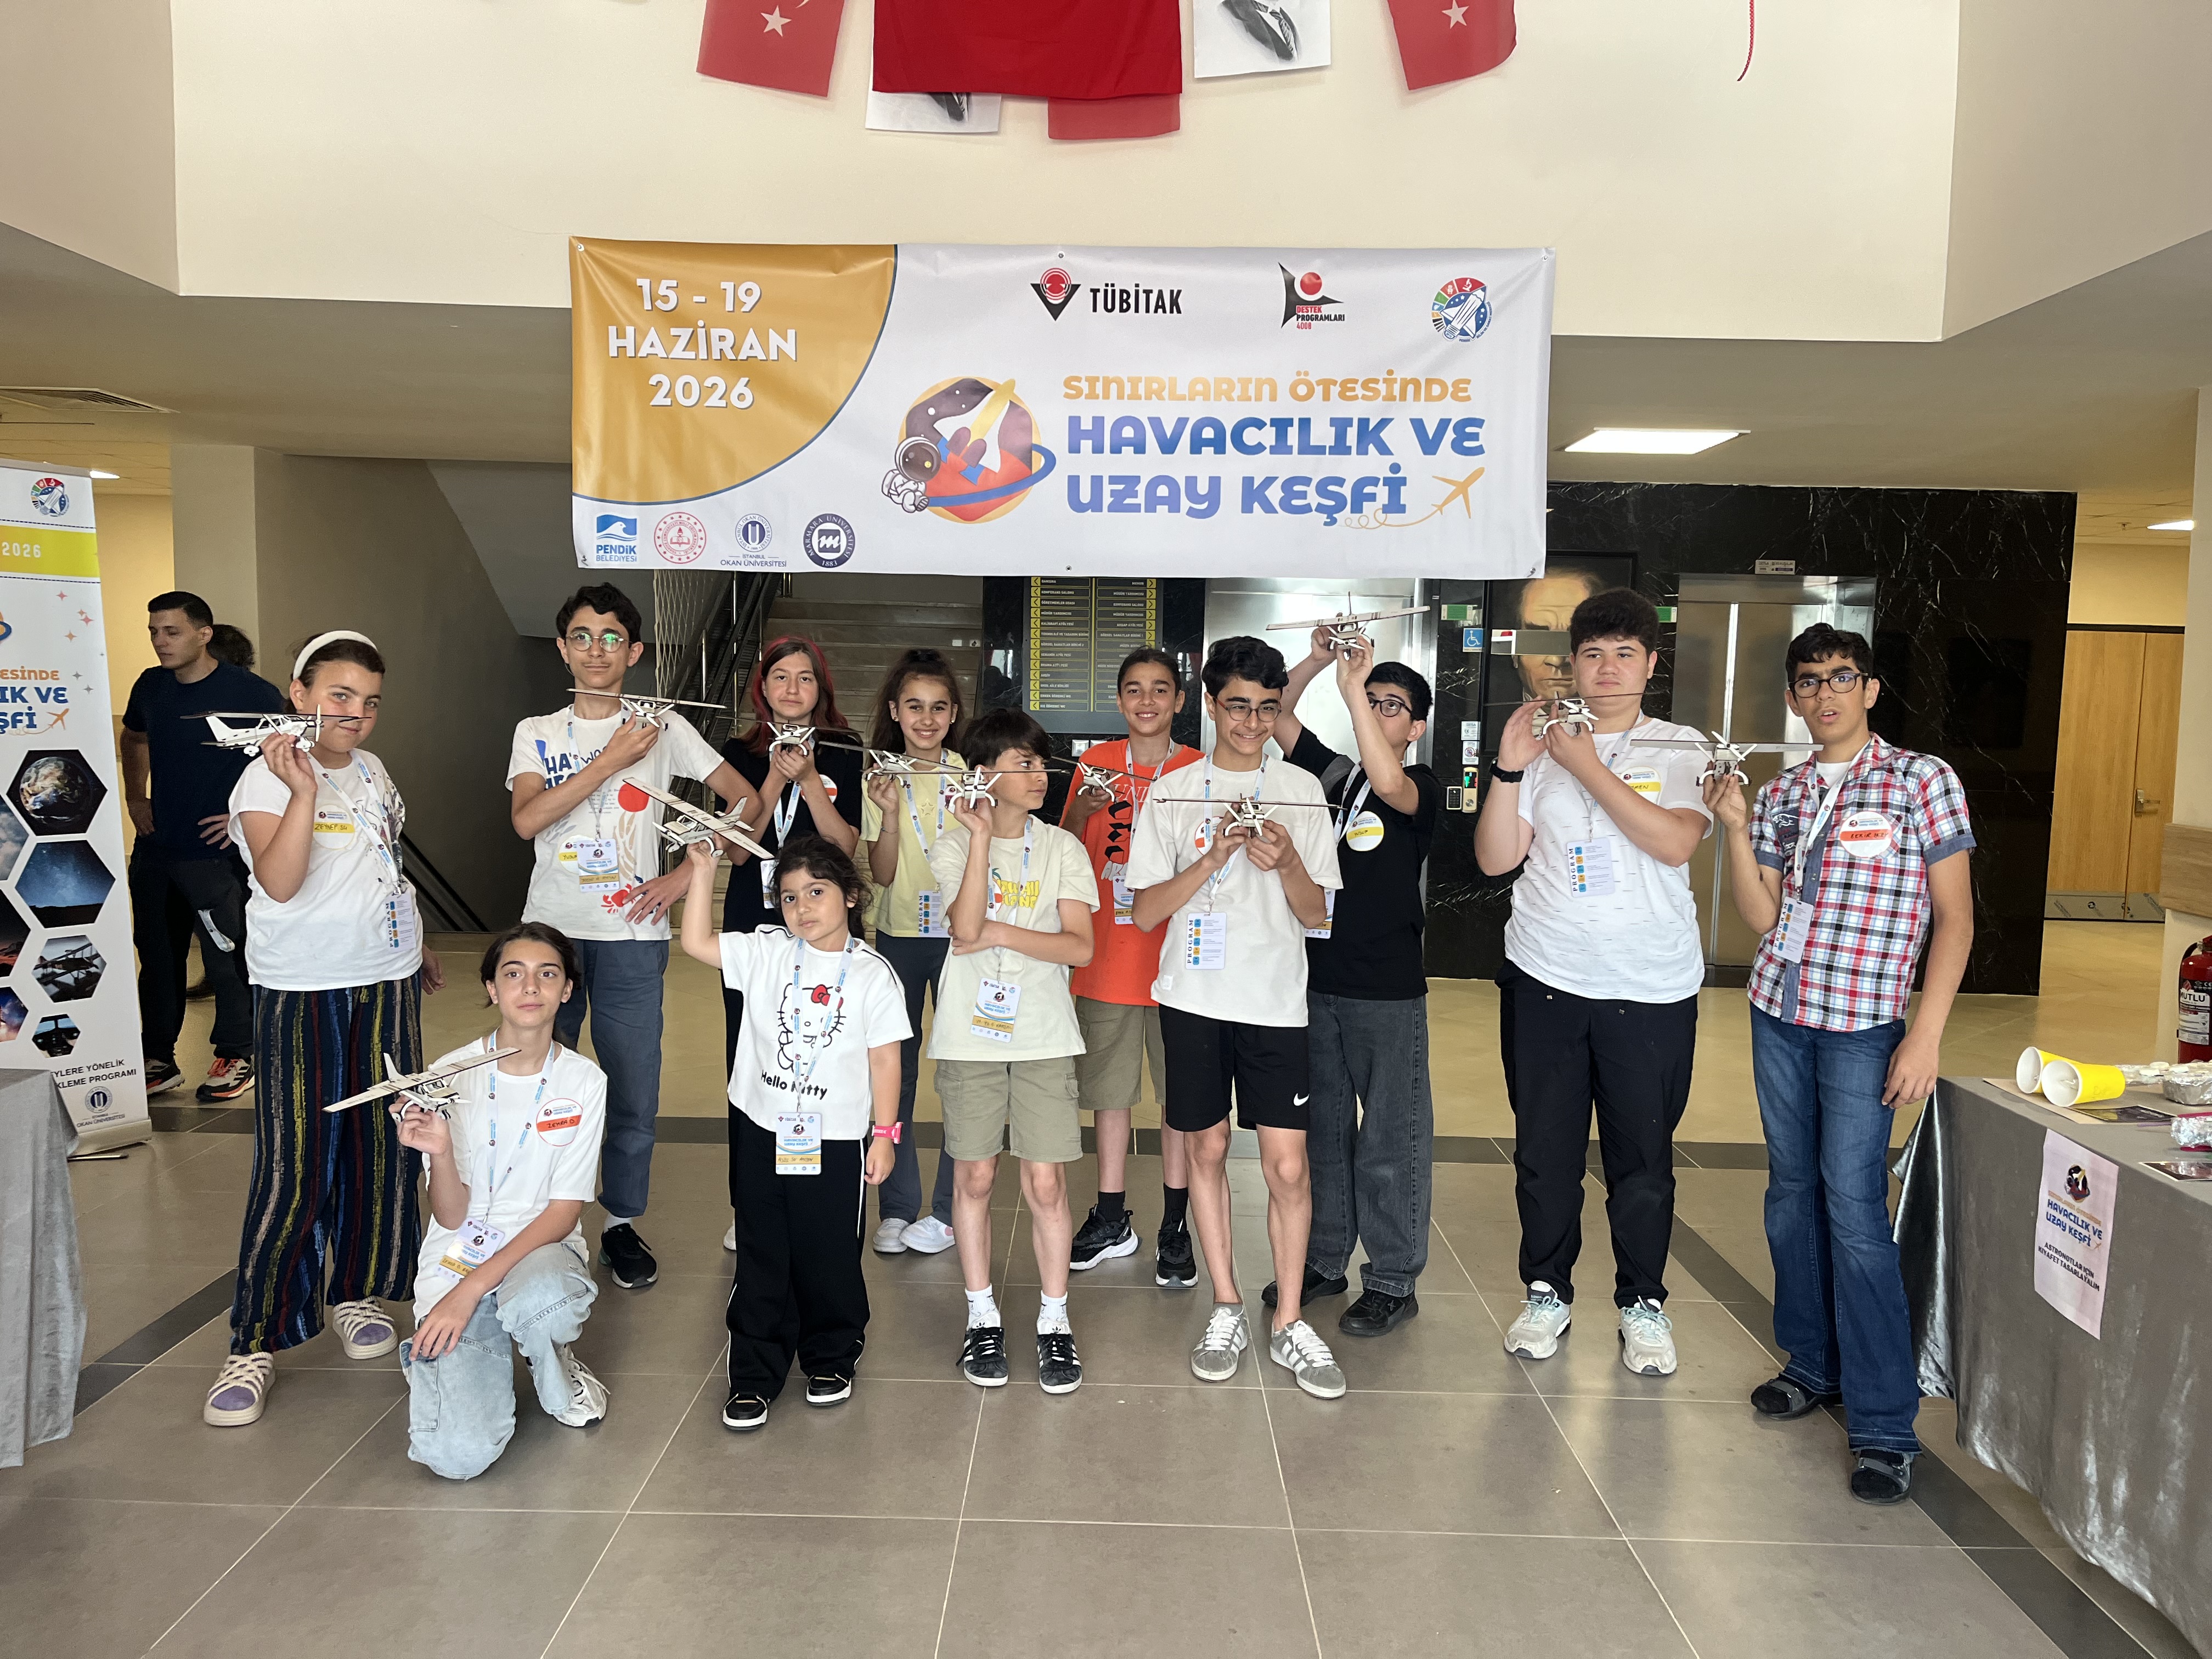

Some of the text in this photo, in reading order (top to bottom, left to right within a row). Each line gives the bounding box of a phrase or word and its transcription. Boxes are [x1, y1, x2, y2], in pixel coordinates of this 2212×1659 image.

[636, 279, 678, 312] 15
[720, 281, 761, 312] 19
[1090, 282, 1183, 315] TÜBİTAK
[608, 319, 797, 362] HAZİRAN
[648, 374, 754, 409] 2026
[1063, 369, 1472, 403] SINIRLARIN ÖTESİNDE
[1068, 415, 1486, 457] HAVACILIK VE
[1068, 462, 1408, 526] UZAY KEŞFİ
[2, 542, 41, 558] 2026
[805, 518, 823, 556] MARMARA
[34, 687, 69, 704] VE
[1568, 848, 1578, 891] PROGRAM
[51, 1059, 125, 1077] YLERE YÖNELİK
[89, 1069, 137, 1083] PROGRAMI
[761, 1069, 787, 1090] Hello
[2046, 1211, 2091, 1246] UZAY KEŞFİ
[2047, 1199, 2102, 1240] HAVACILIK VE
[2038, 1245, 2100, 1291] KIYAFET TASARLAYALIM
[2044, 1242, 2083, 1270] ASTRONOTLAR
